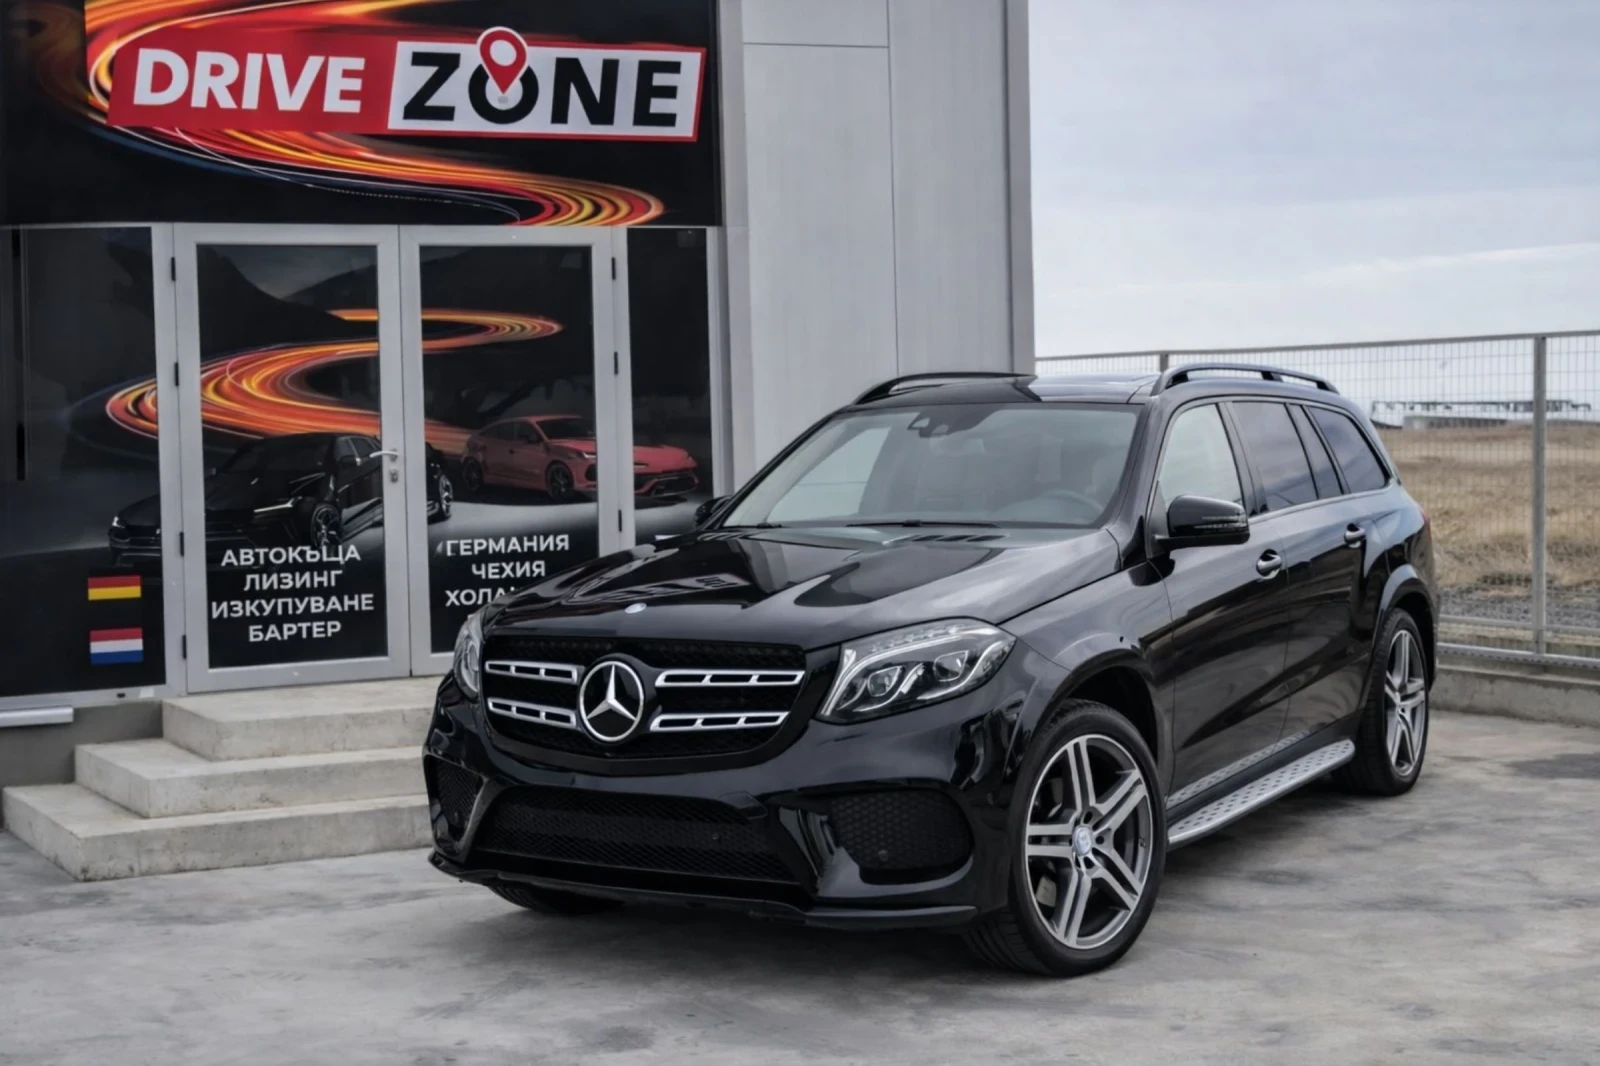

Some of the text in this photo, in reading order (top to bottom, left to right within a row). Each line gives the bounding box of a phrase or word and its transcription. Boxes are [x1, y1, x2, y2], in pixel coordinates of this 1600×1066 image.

[133, 47, 682, 127] DRIVE ZONE
[220, 544, 362, 567] АВТОКЪЩА
[446, 534, 570, 556] ГЕРМАНИЯ
[243, 570, 343, 591] ЛИЗИНГ
[471, 560, 546, 579] ЧЕХИЯ
[211, 593, 375, 619] ИЗКУПУВАНЕ
[248, 620, 342, 642] БАРТЕР
